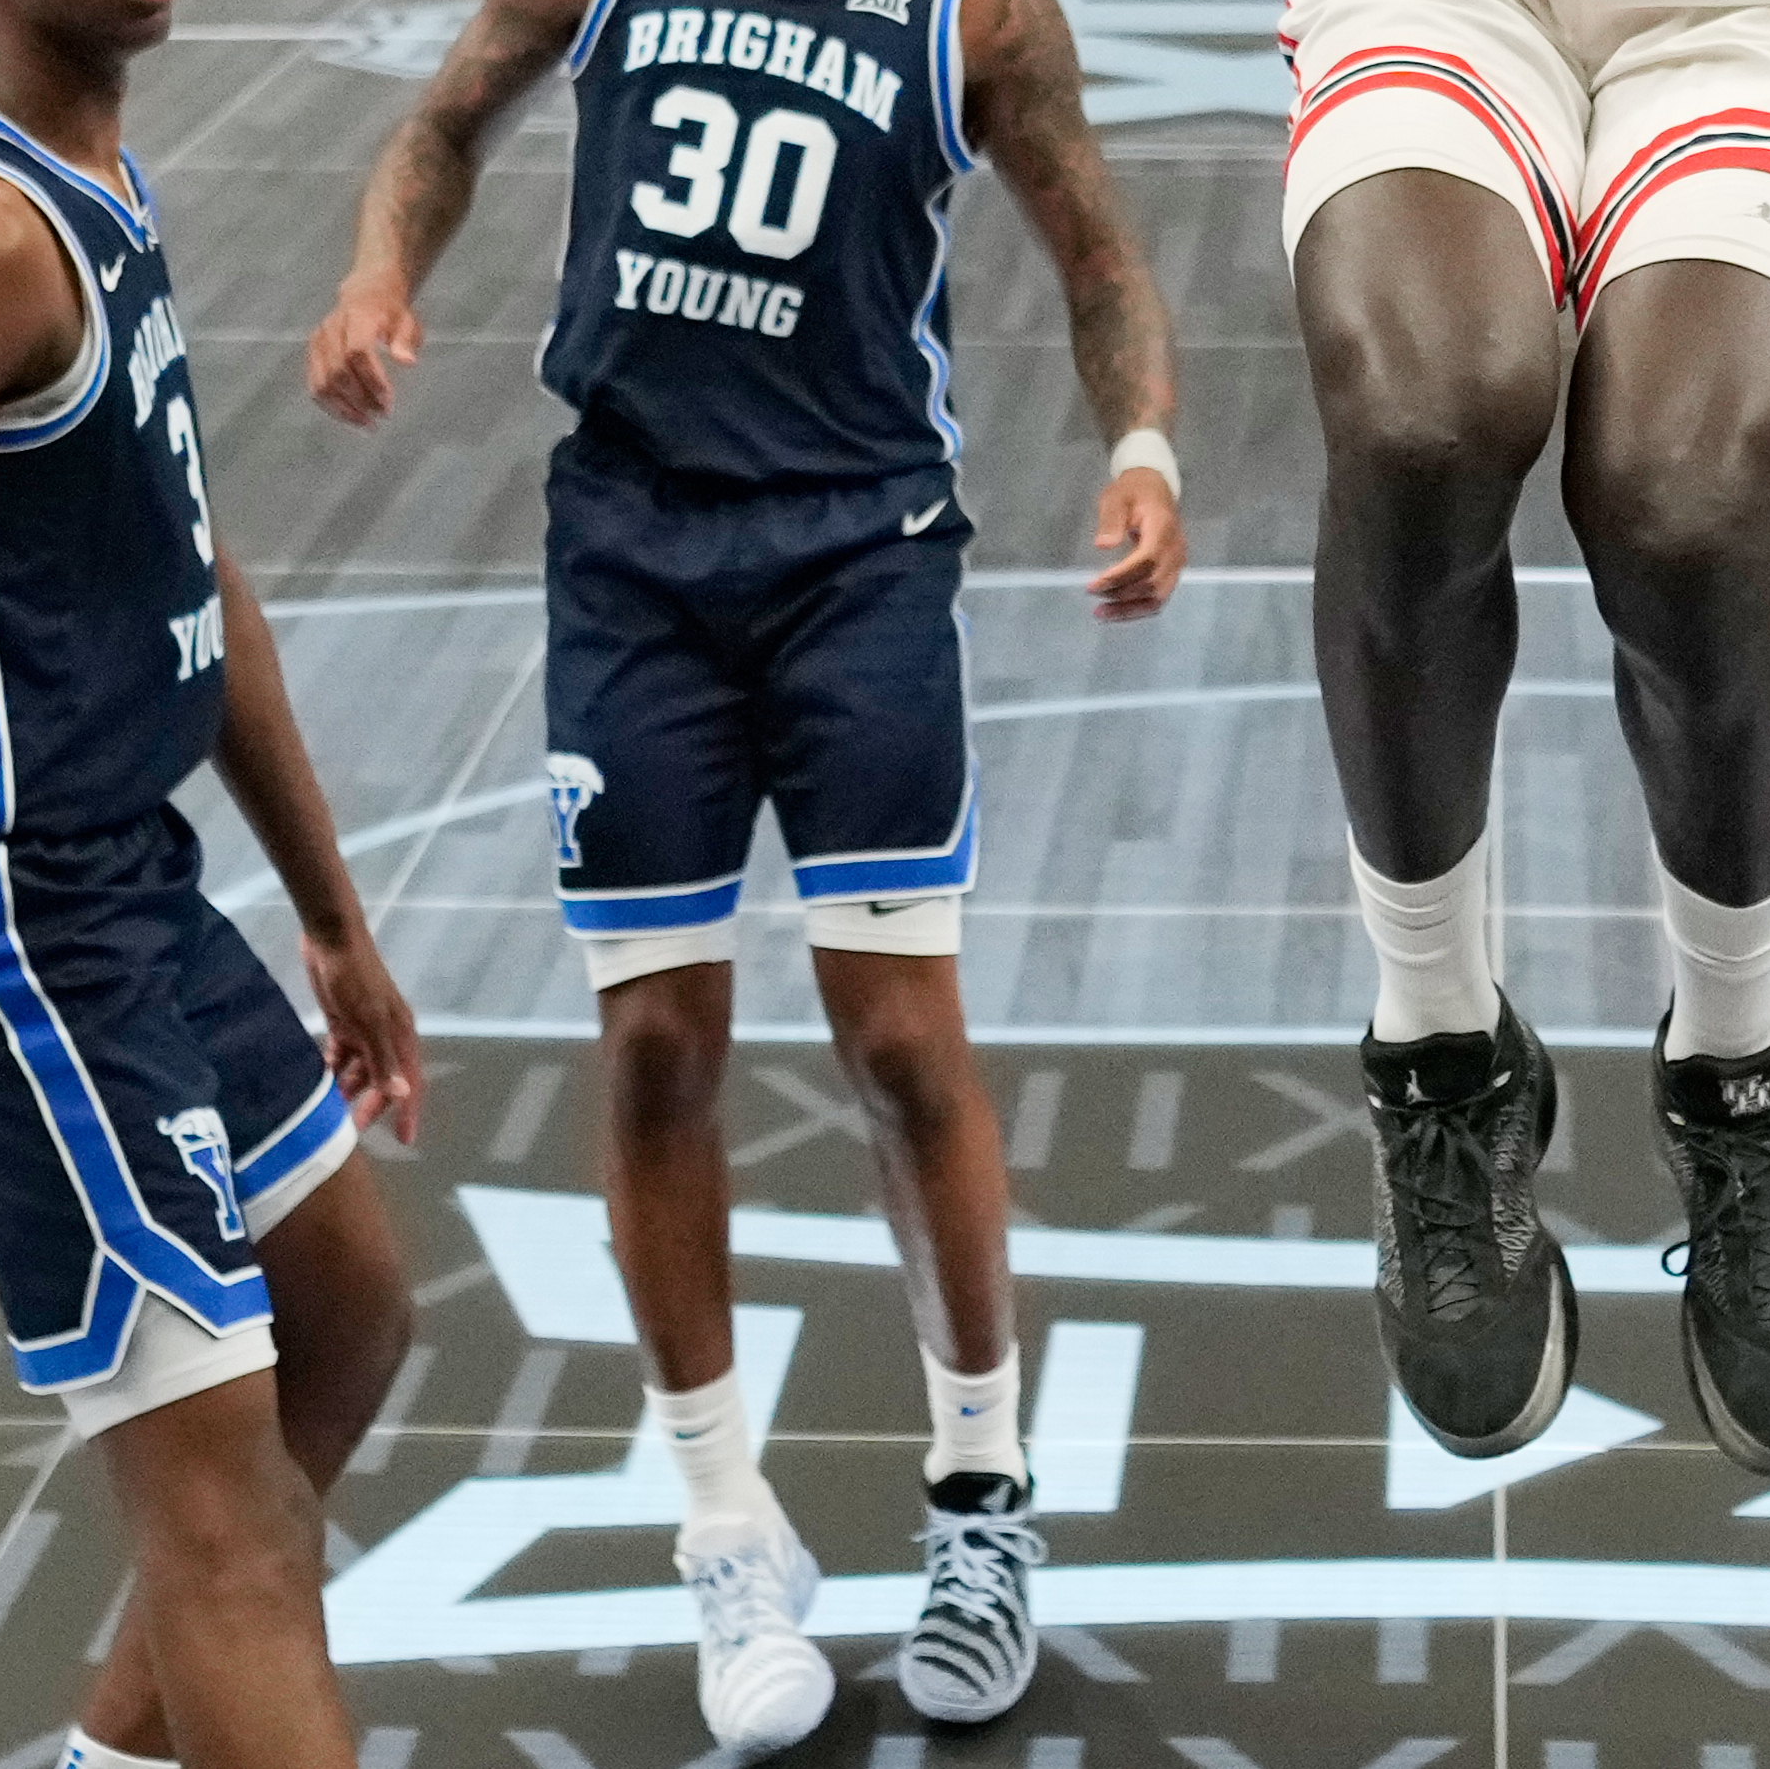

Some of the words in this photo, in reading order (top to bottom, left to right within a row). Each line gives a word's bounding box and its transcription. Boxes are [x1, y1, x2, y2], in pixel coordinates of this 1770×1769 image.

[624, 6, 903, 132] BRIGHAM
[631, 85, 837, 260] 30
[614, 250, 804, 338] YOUNG
